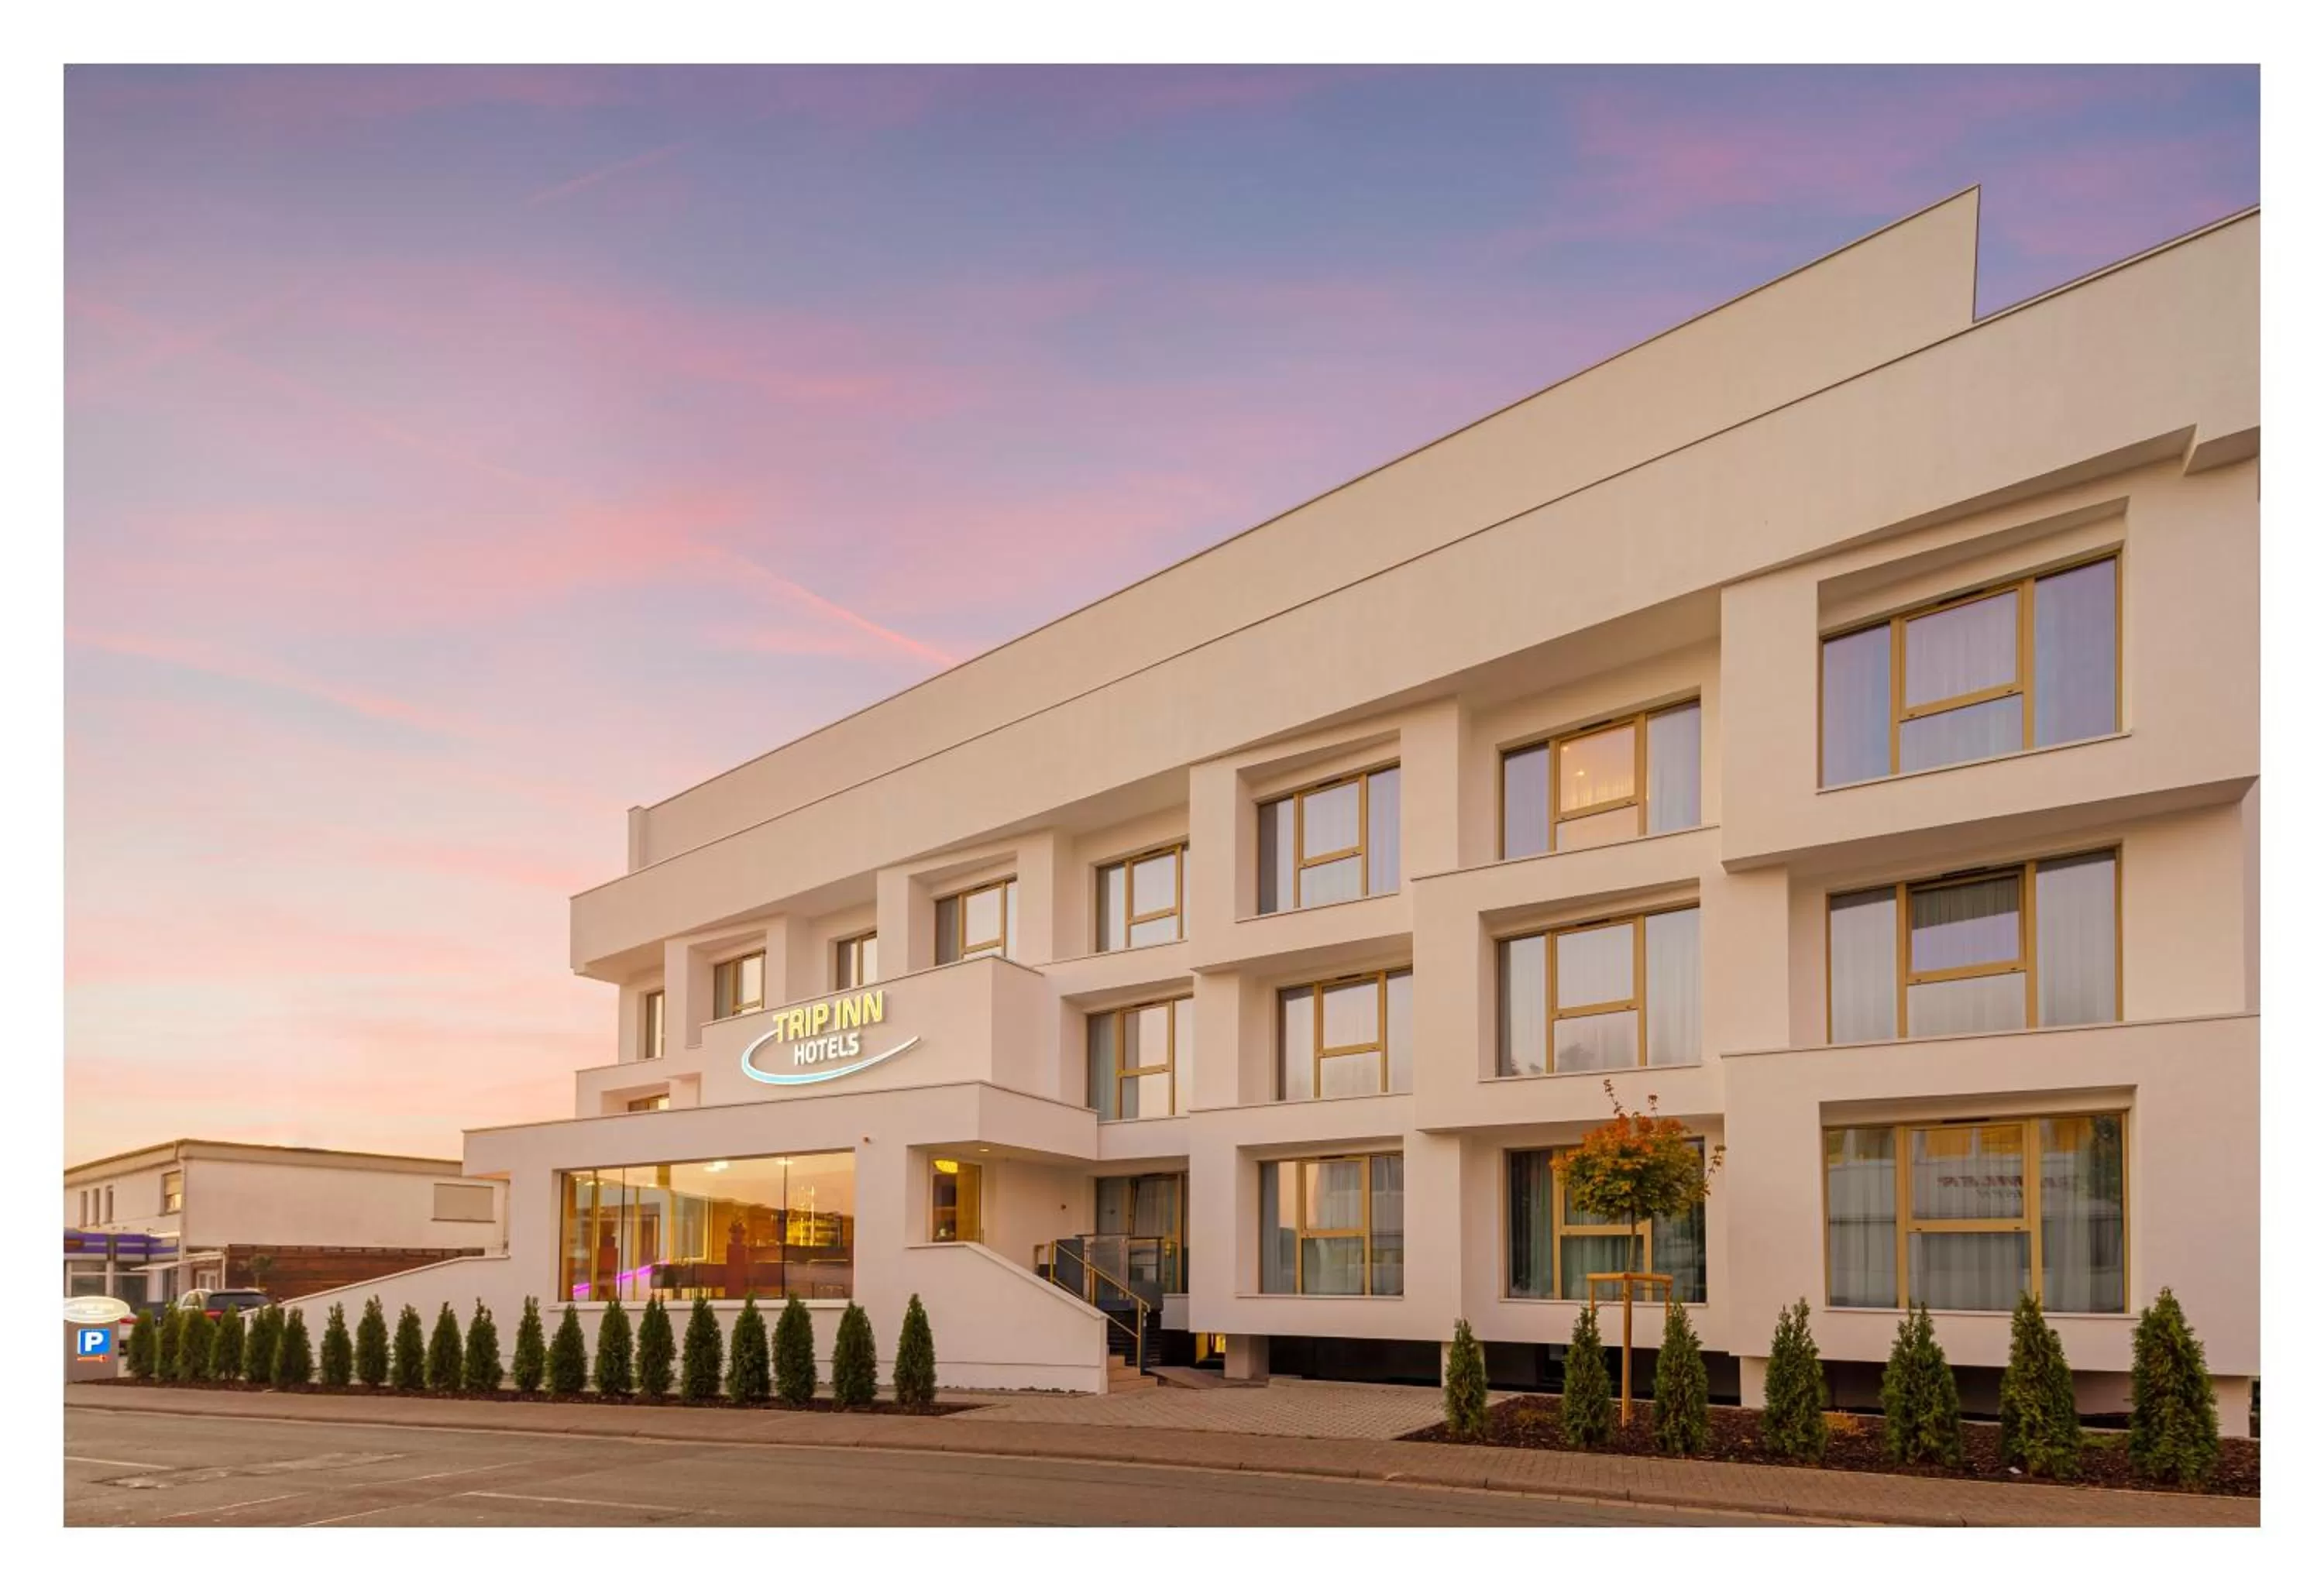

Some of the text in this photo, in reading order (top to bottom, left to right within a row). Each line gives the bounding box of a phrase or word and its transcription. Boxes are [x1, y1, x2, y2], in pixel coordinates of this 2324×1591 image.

[772, 990, 885, 1043] TRIP INN
[794, 1033, 860, 1065] HOTELS
[84, 1332, 104, 1352] P
